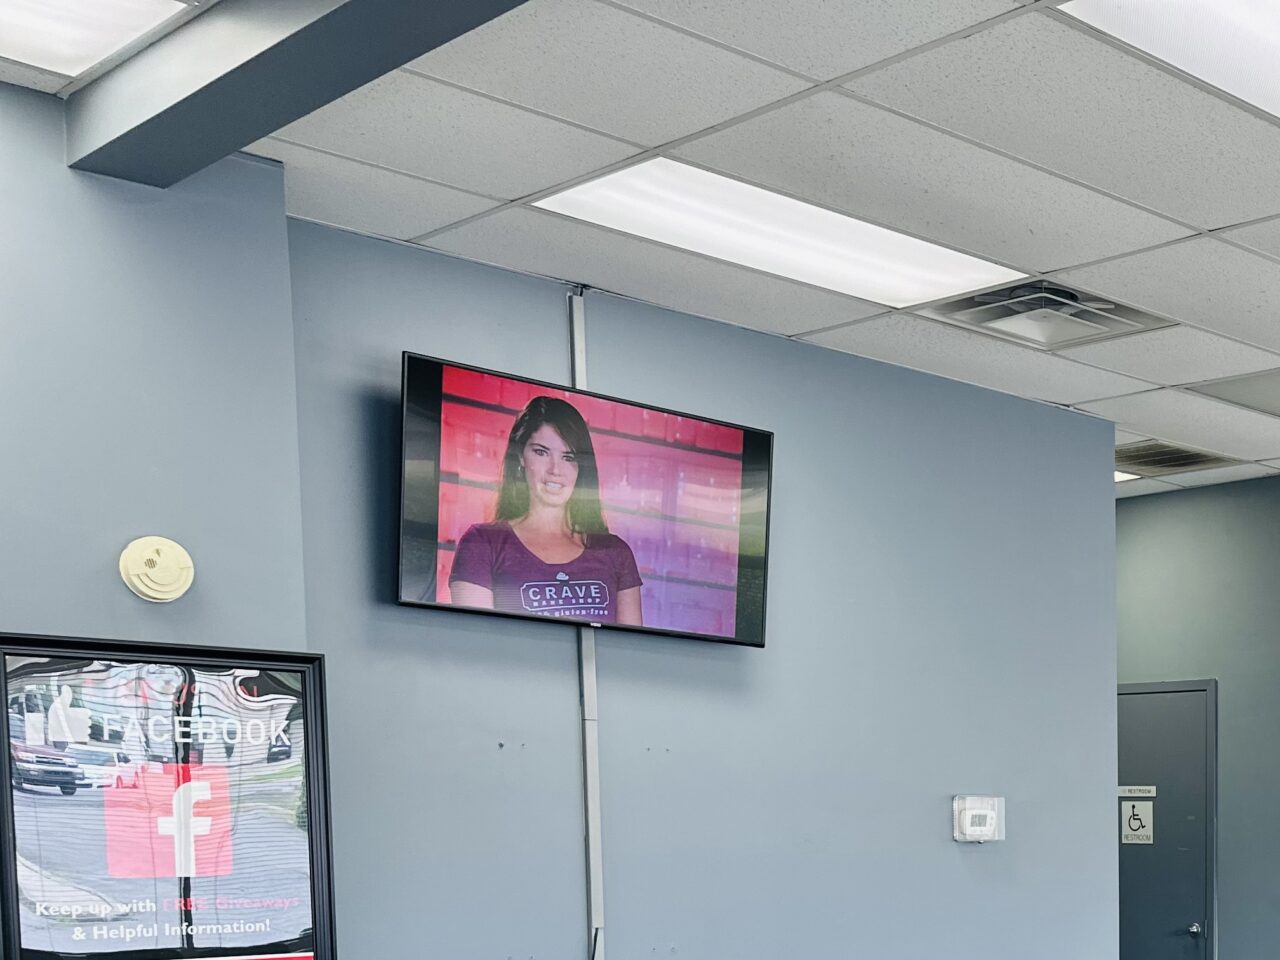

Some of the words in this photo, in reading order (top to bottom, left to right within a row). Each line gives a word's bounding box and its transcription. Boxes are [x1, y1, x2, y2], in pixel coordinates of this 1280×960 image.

[528, 585, 601, 600] CRAVE
[103, 714, 291, 746] FACEBOOK
[35, 901, 82, 918] Keep
[89, 904, 112, 917] up
[117, 899, 156, 914] with
[72, 927, 86, 940] &
[93, 924, 158, 941] Helpful
[165, 919, 271, 936] Information!
